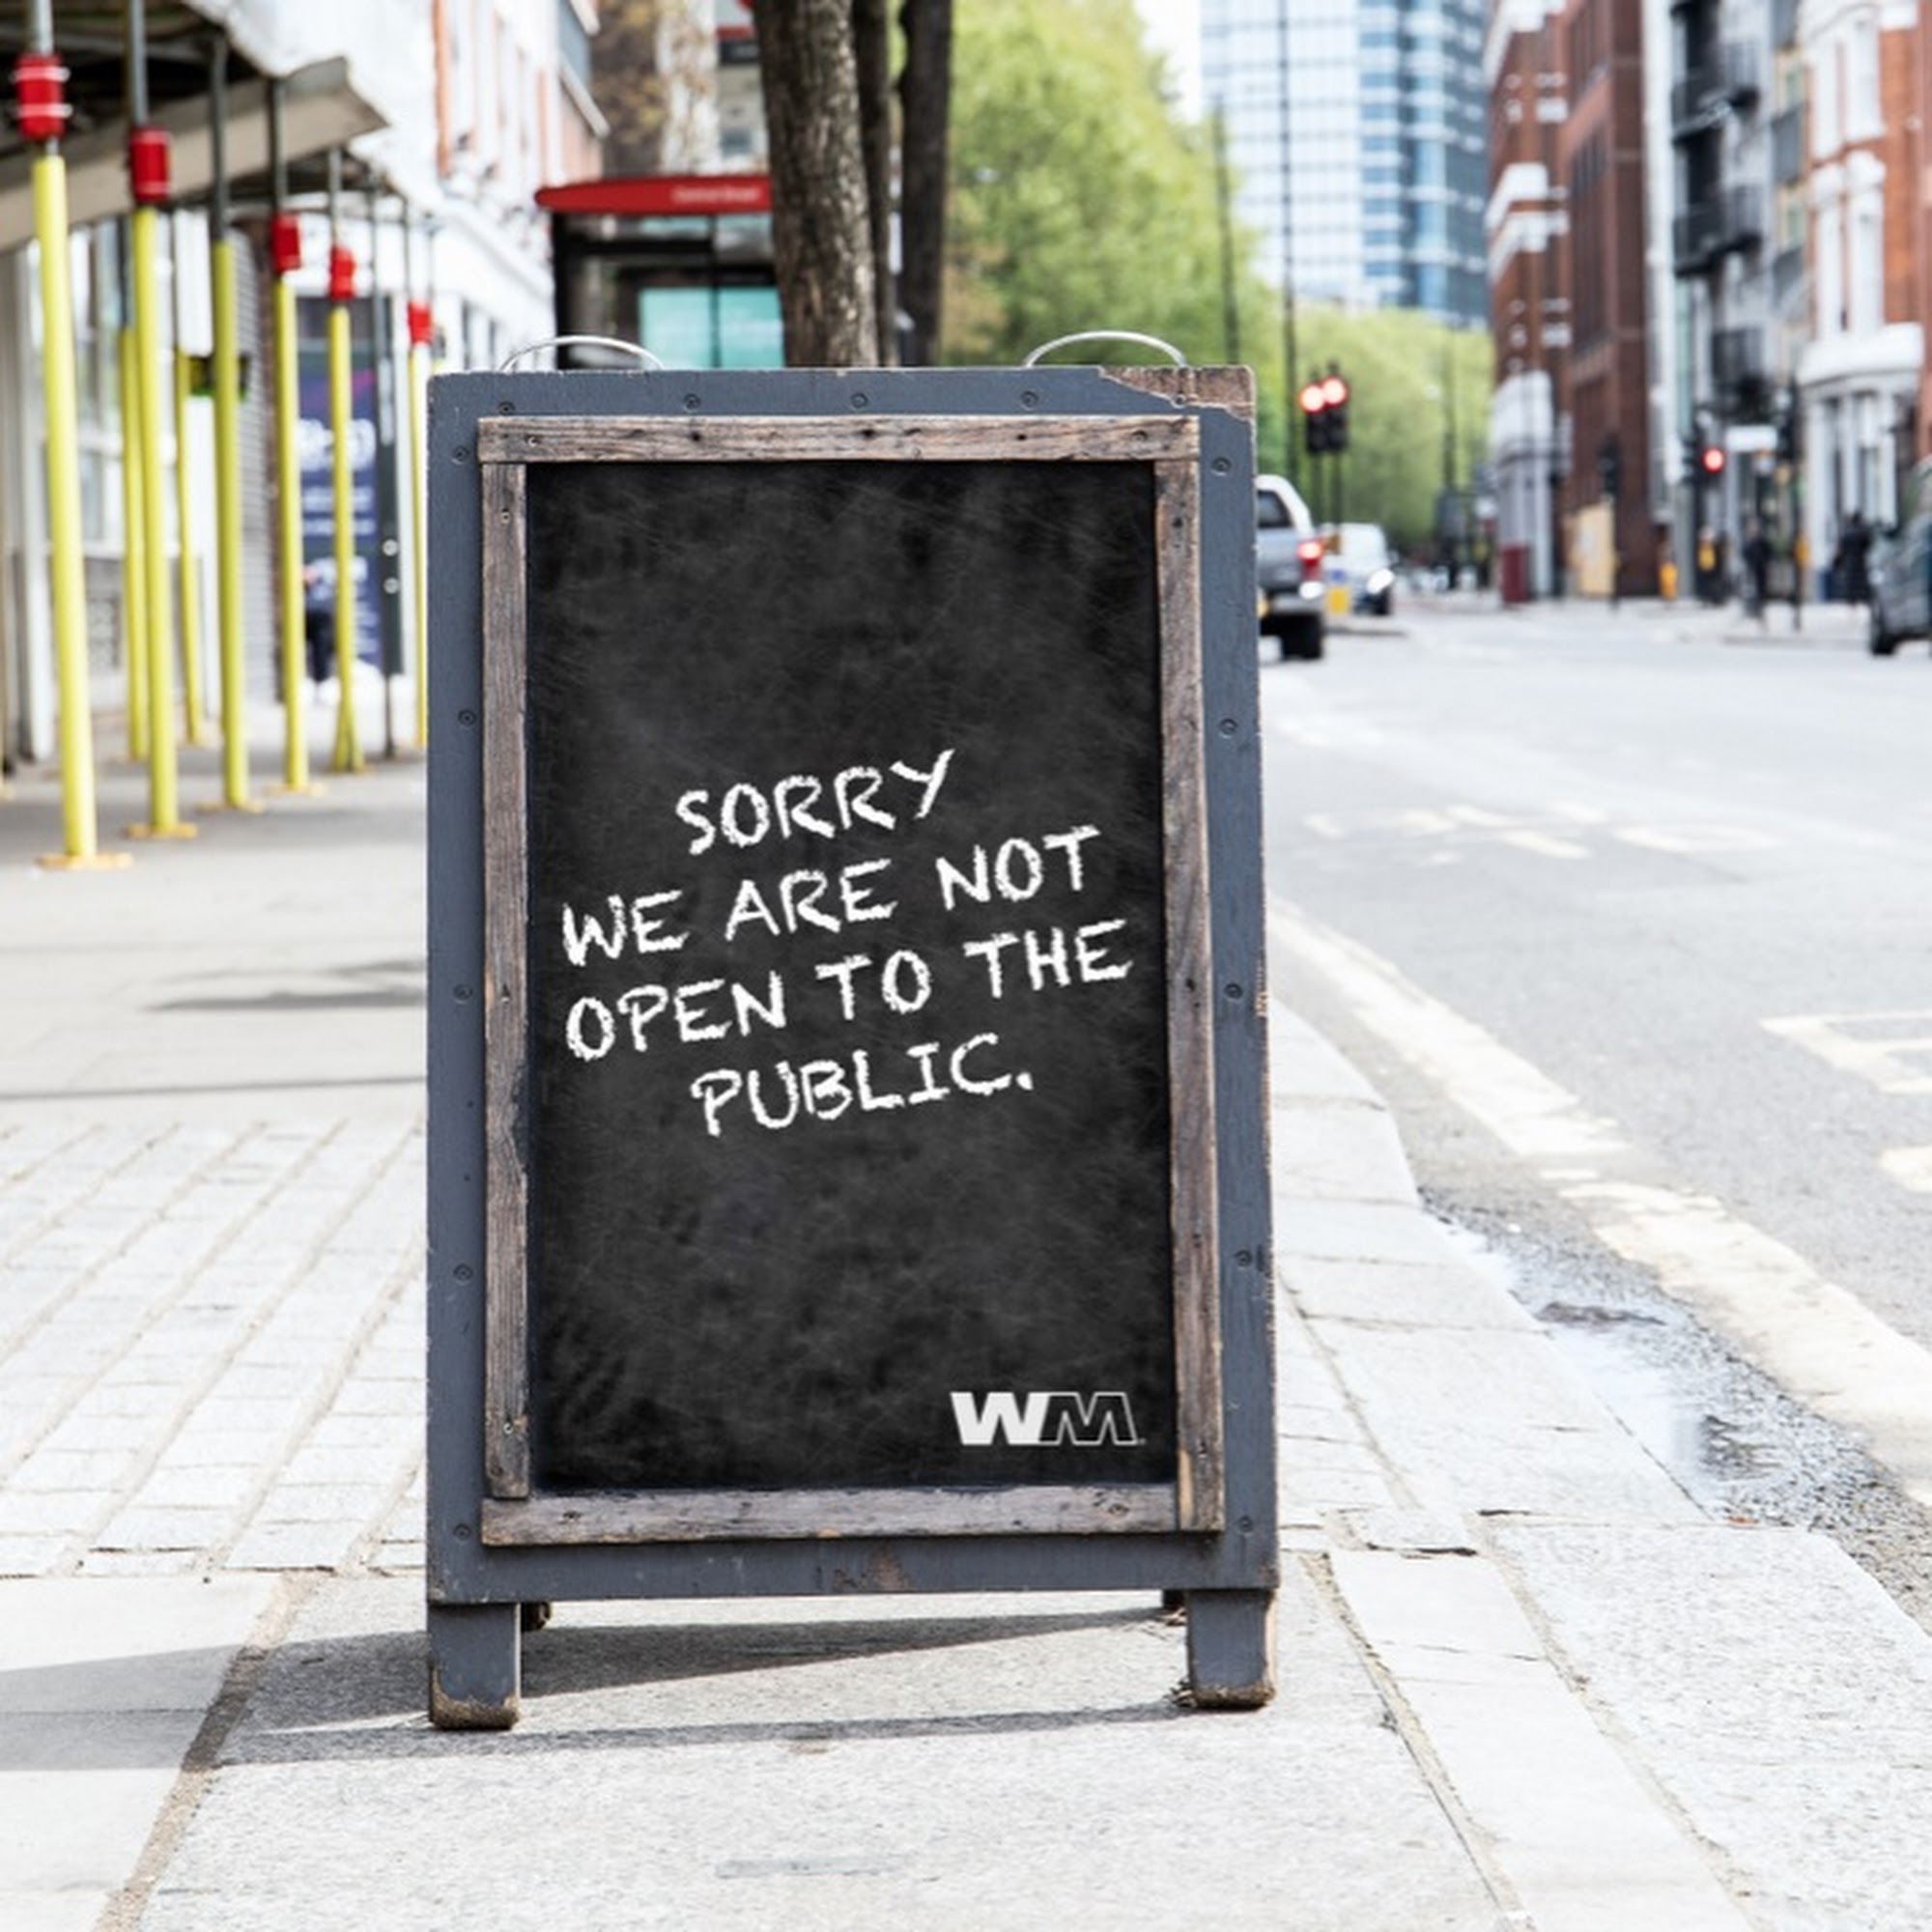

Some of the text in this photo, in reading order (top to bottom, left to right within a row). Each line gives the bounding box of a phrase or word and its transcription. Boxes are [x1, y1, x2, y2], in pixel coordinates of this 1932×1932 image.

[676, 750, 954, 855] SORRY
[563, 825, 1100, 966] WE ARE NOT
[566, 920, 1132, 1061] OPEN TO THE
[690, 1033, 1034, 1136] PUBLIC.
[951, 1391, 1138, 1445] WM
